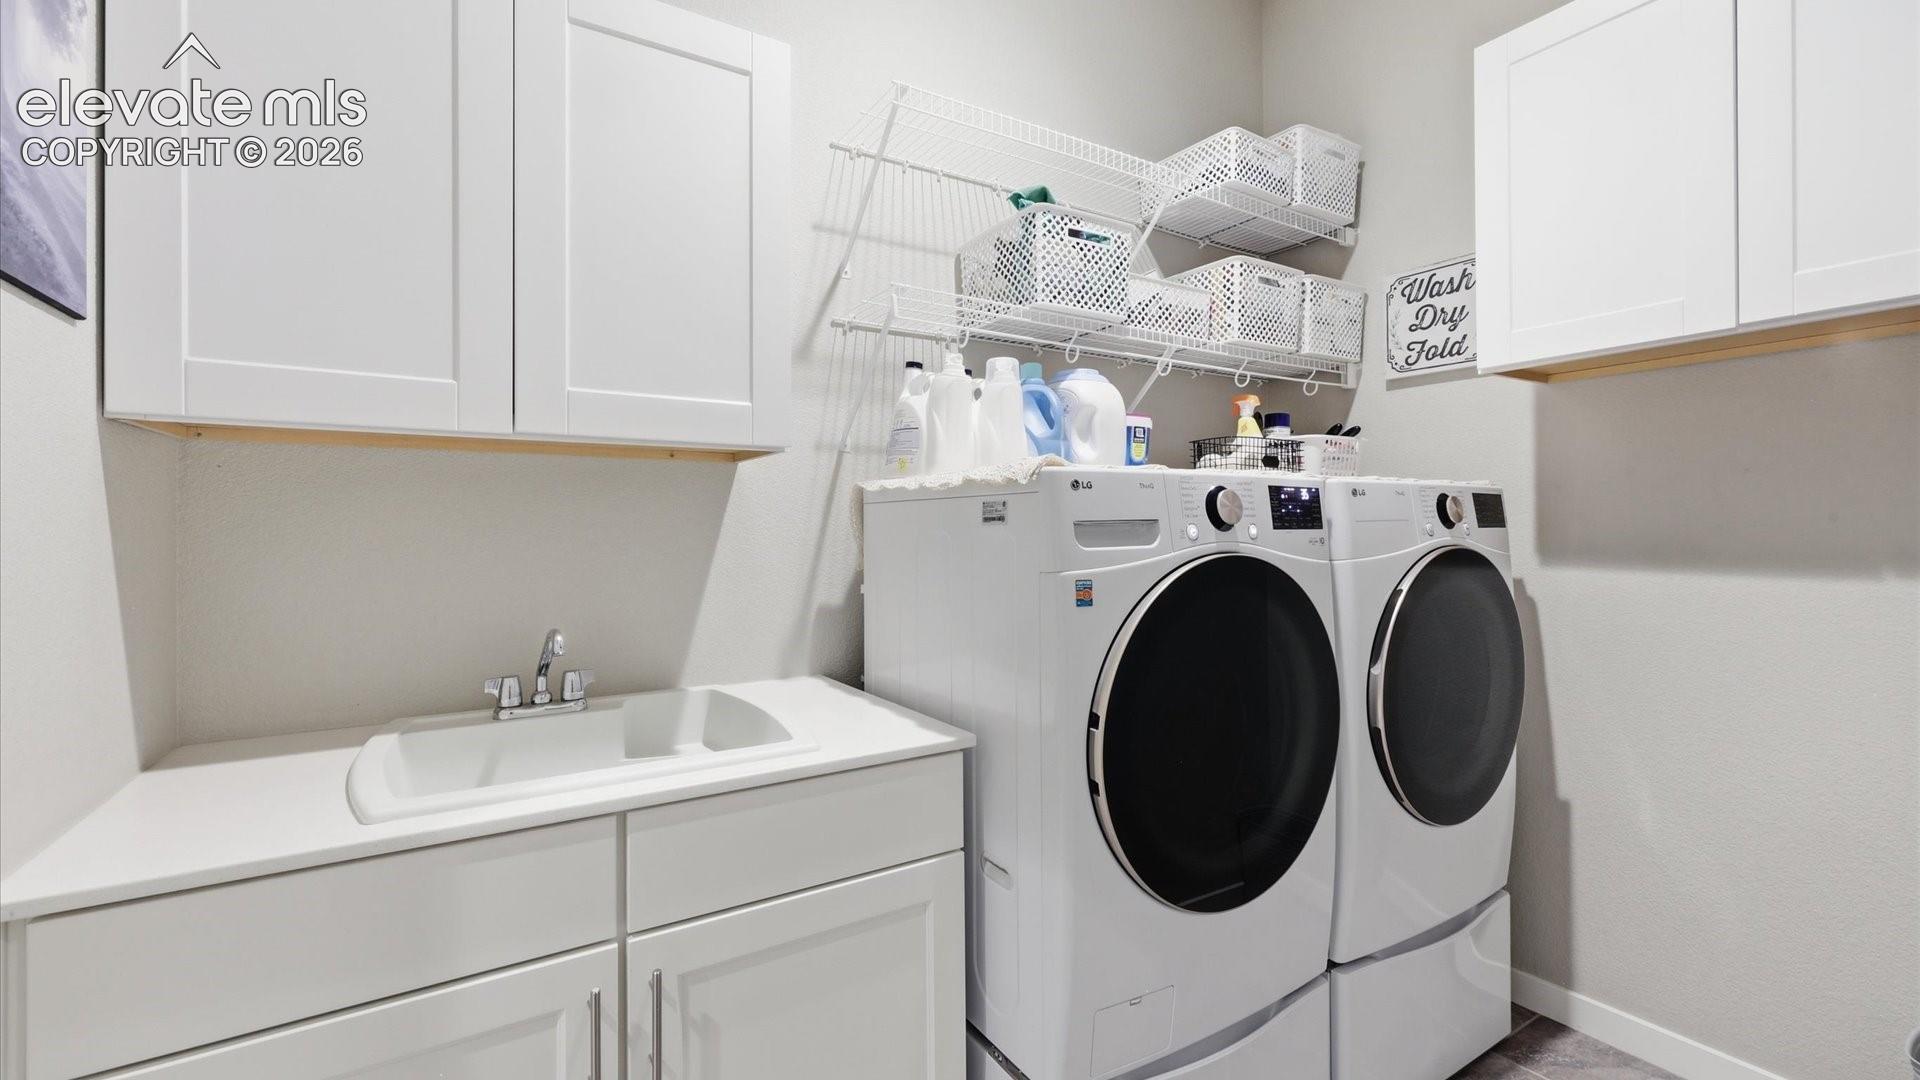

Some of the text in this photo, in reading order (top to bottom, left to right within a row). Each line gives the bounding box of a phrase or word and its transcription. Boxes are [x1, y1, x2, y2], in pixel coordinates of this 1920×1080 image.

[1400, 267, 1476, 305] Wash
[1408, 303, 1469, 332] Dry
[1405, 333, 1469, 366] Fold
